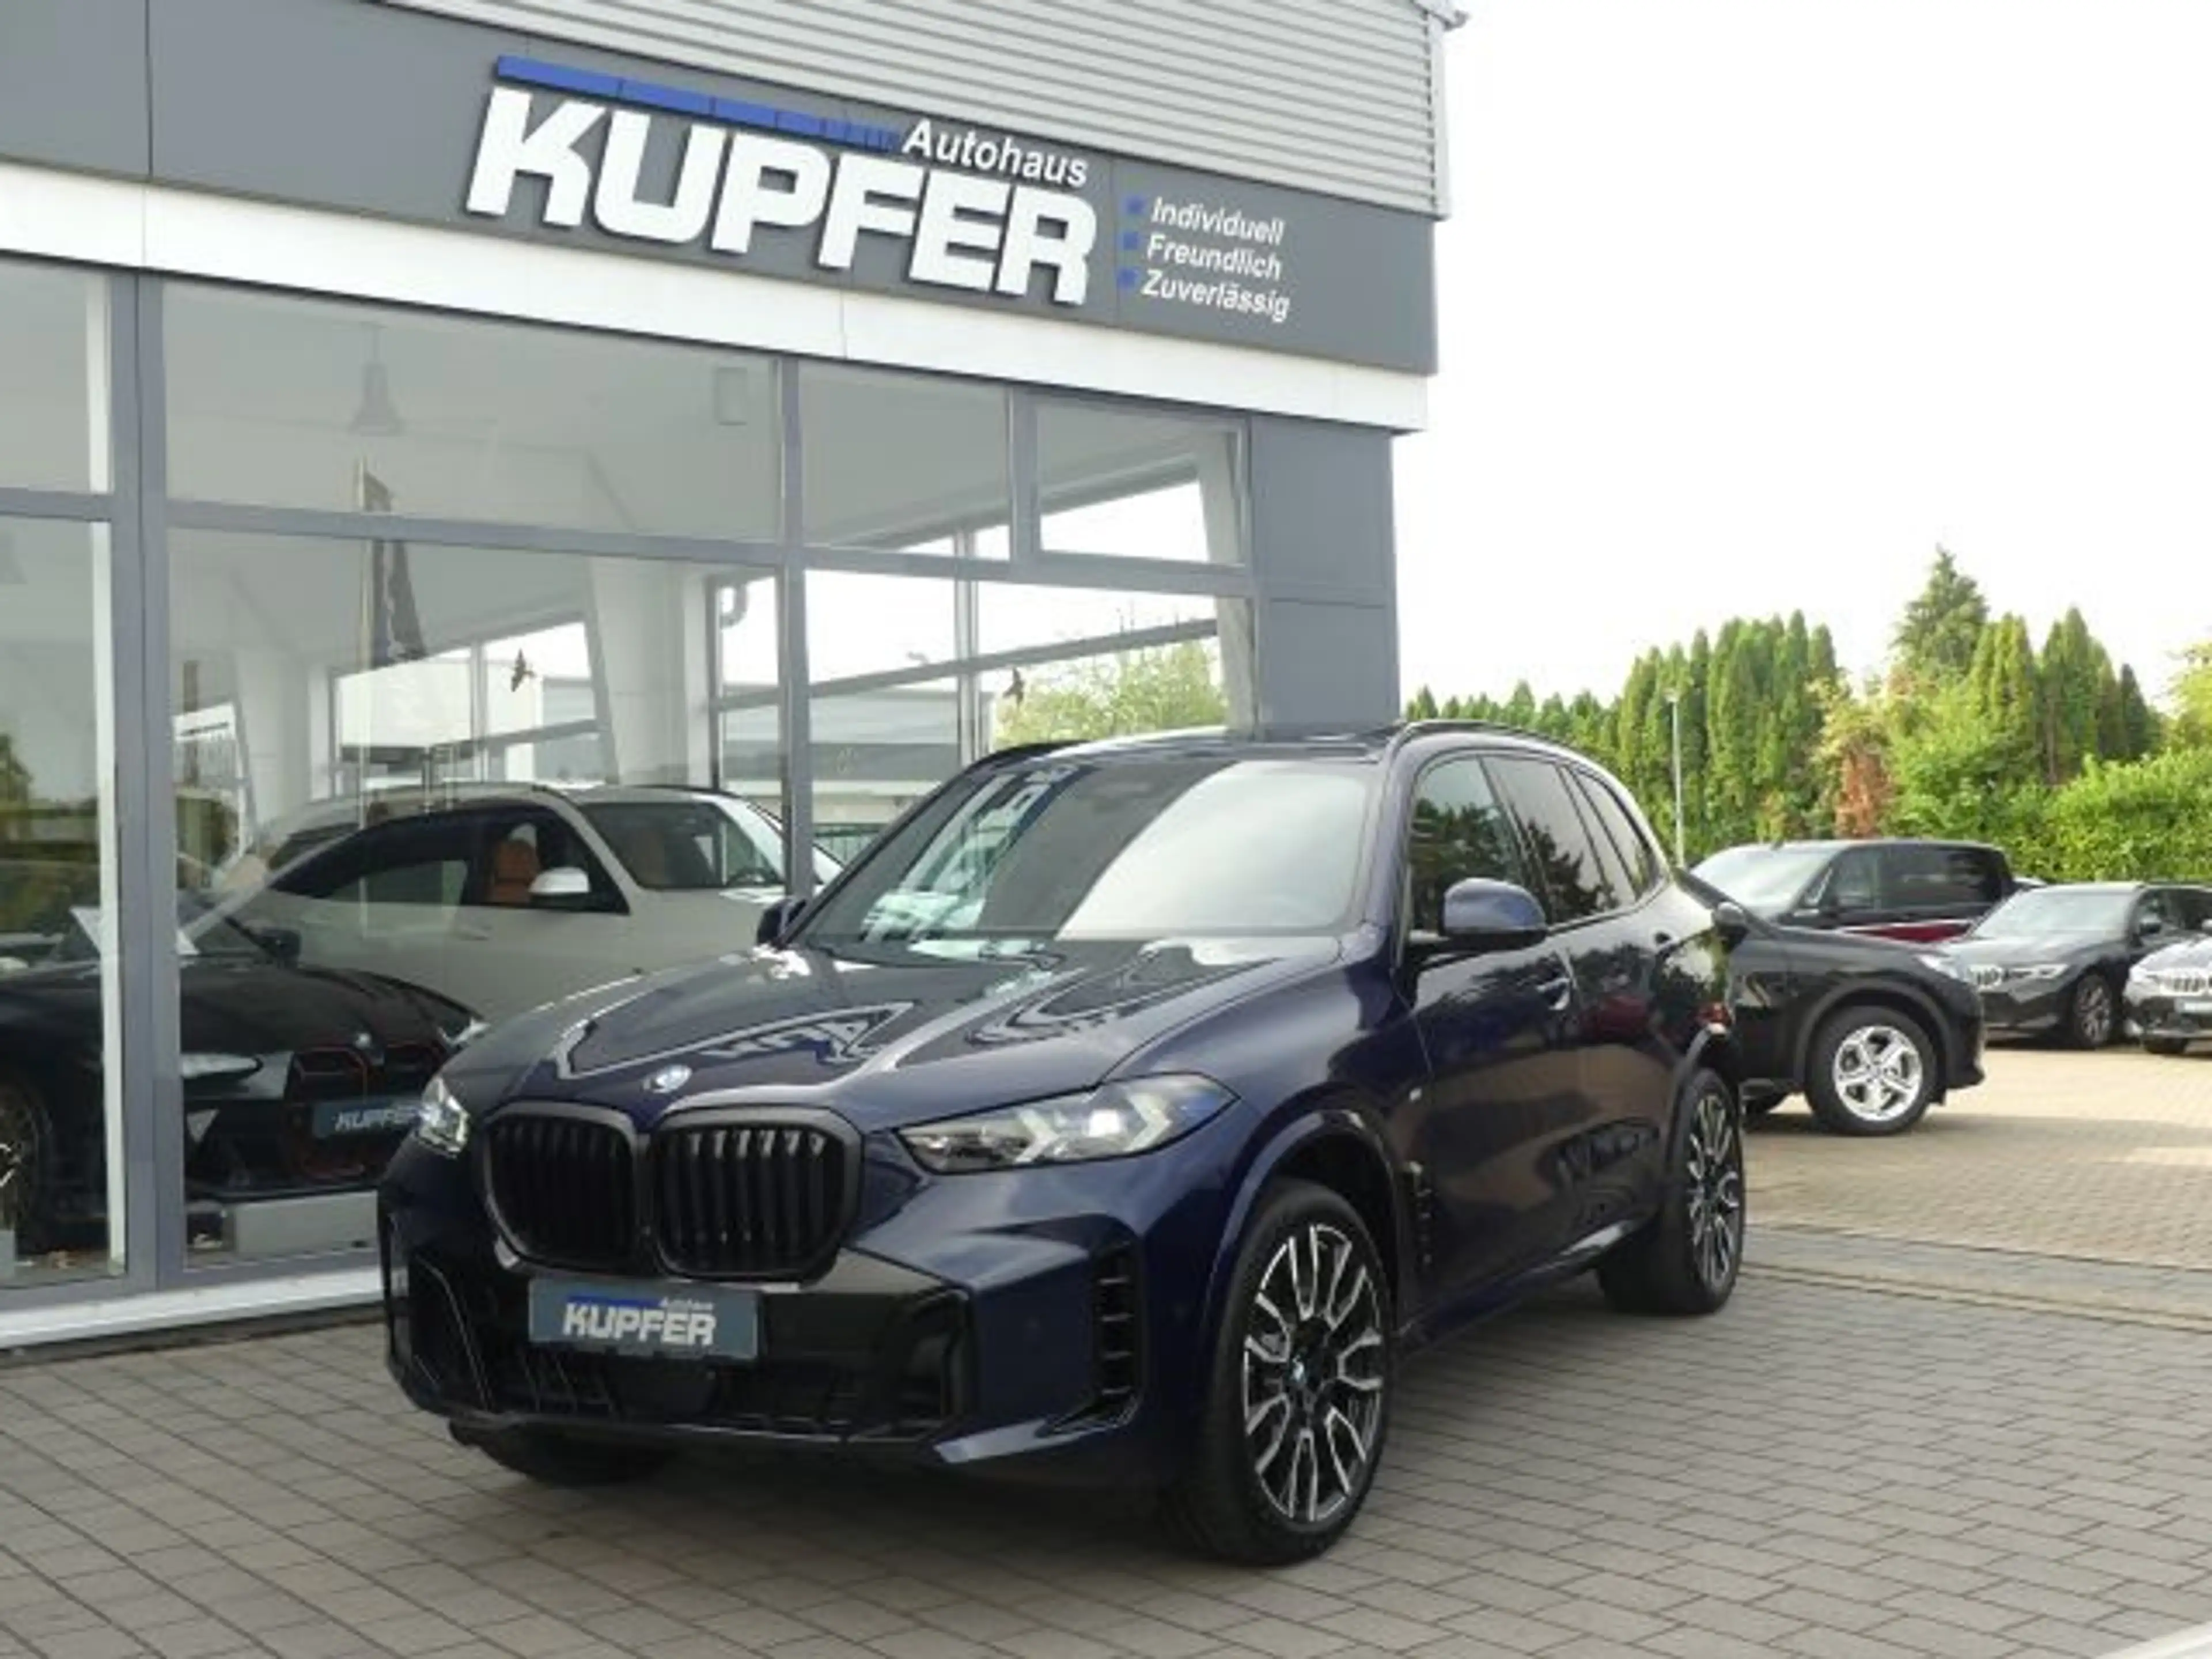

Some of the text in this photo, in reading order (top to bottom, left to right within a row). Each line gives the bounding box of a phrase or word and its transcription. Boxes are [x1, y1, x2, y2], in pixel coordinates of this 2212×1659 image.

[902, 118, 1088, 188] Autohaus
[467, 86, 1096, 305] KUPFER
[1152, 197, 1286, 245] Individuell
[1146, 233, 1281, 281] Freundlich
[1141, 269, 1290, 323] Zuverlässig
[562, 1302, 717, 1346] KUPFER
